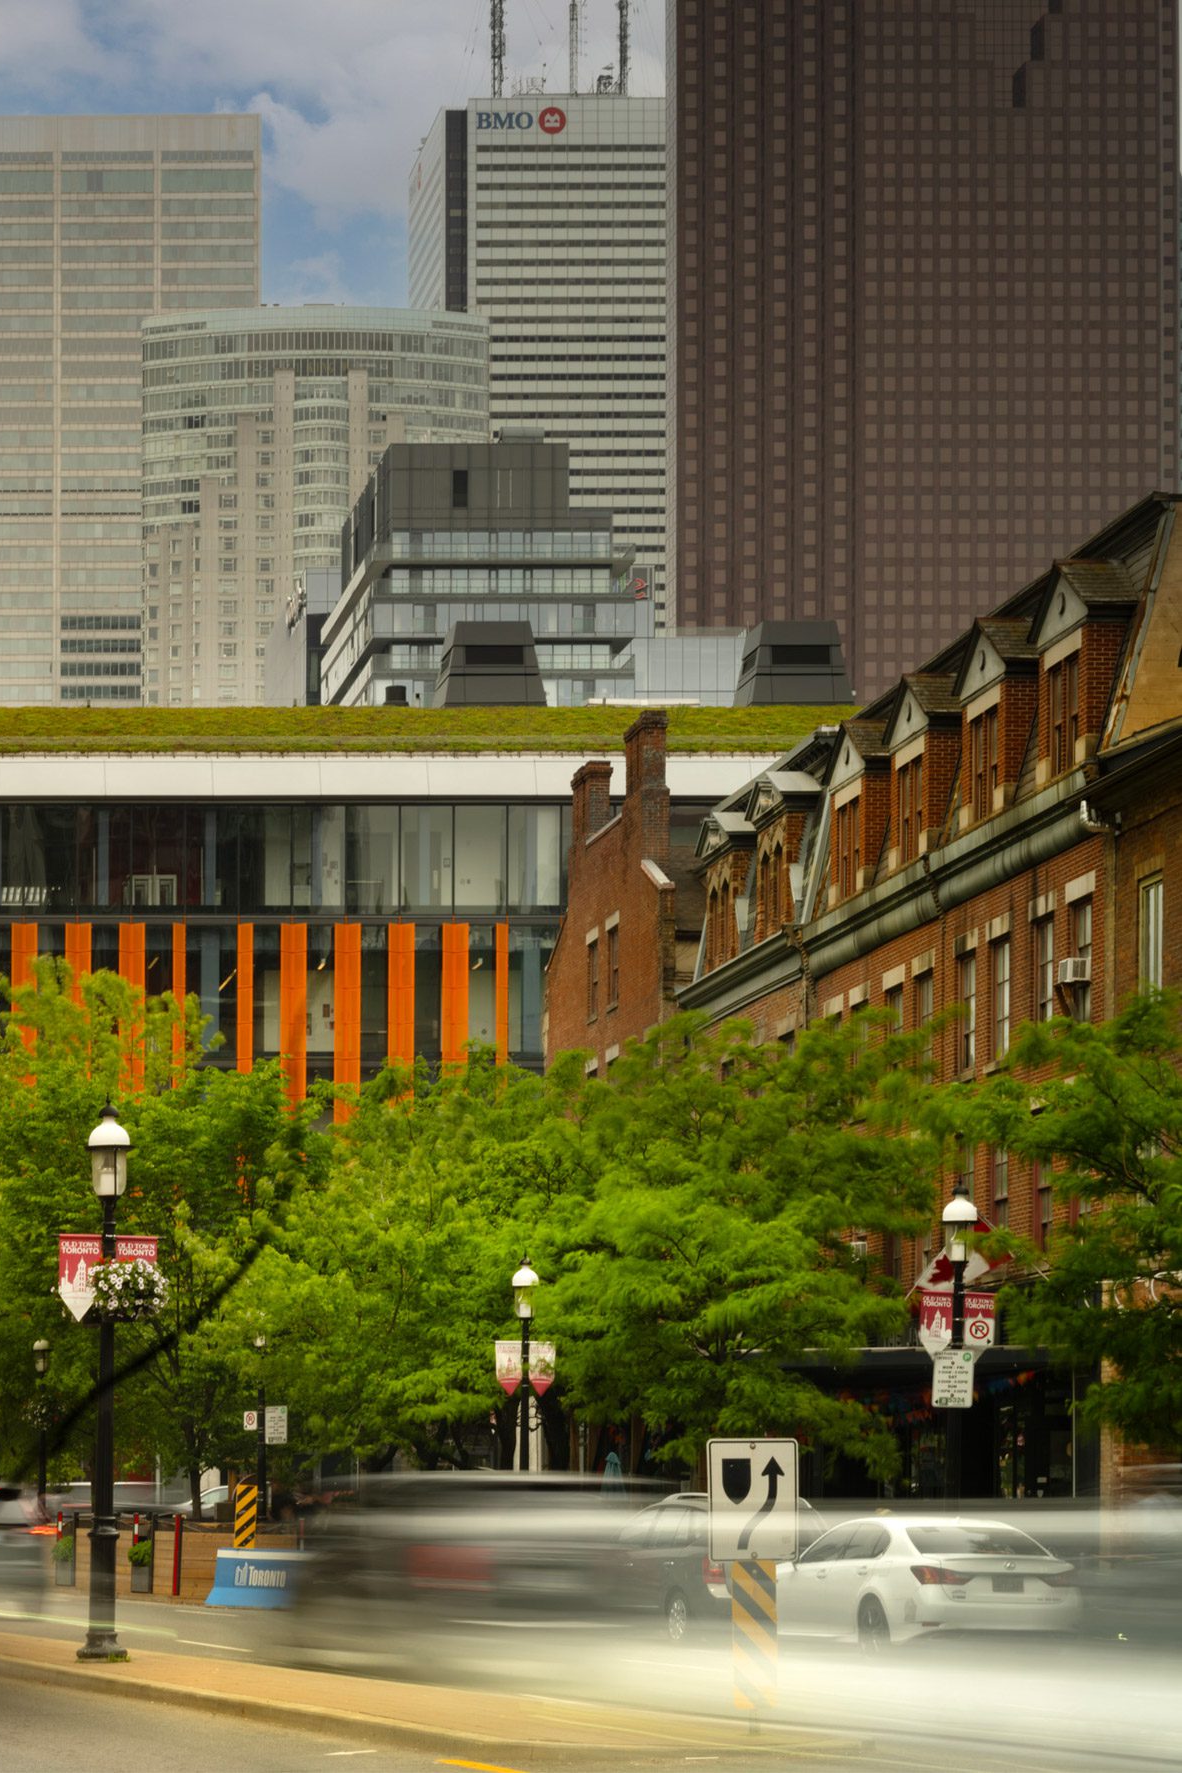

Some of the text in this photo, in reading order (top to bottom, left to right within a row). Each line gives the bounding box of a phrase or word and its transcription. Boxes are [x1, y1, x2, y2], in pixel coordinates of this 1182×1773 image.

[476, 112, 534, 130] BMO
[62, 1247, 100, 1255] TORONTO
[118, 1248, 156, 1257] TORONTO
[965, 1302, 995, 1310] TORONTO
[248, 1566, 287, 1588] TORONTO
